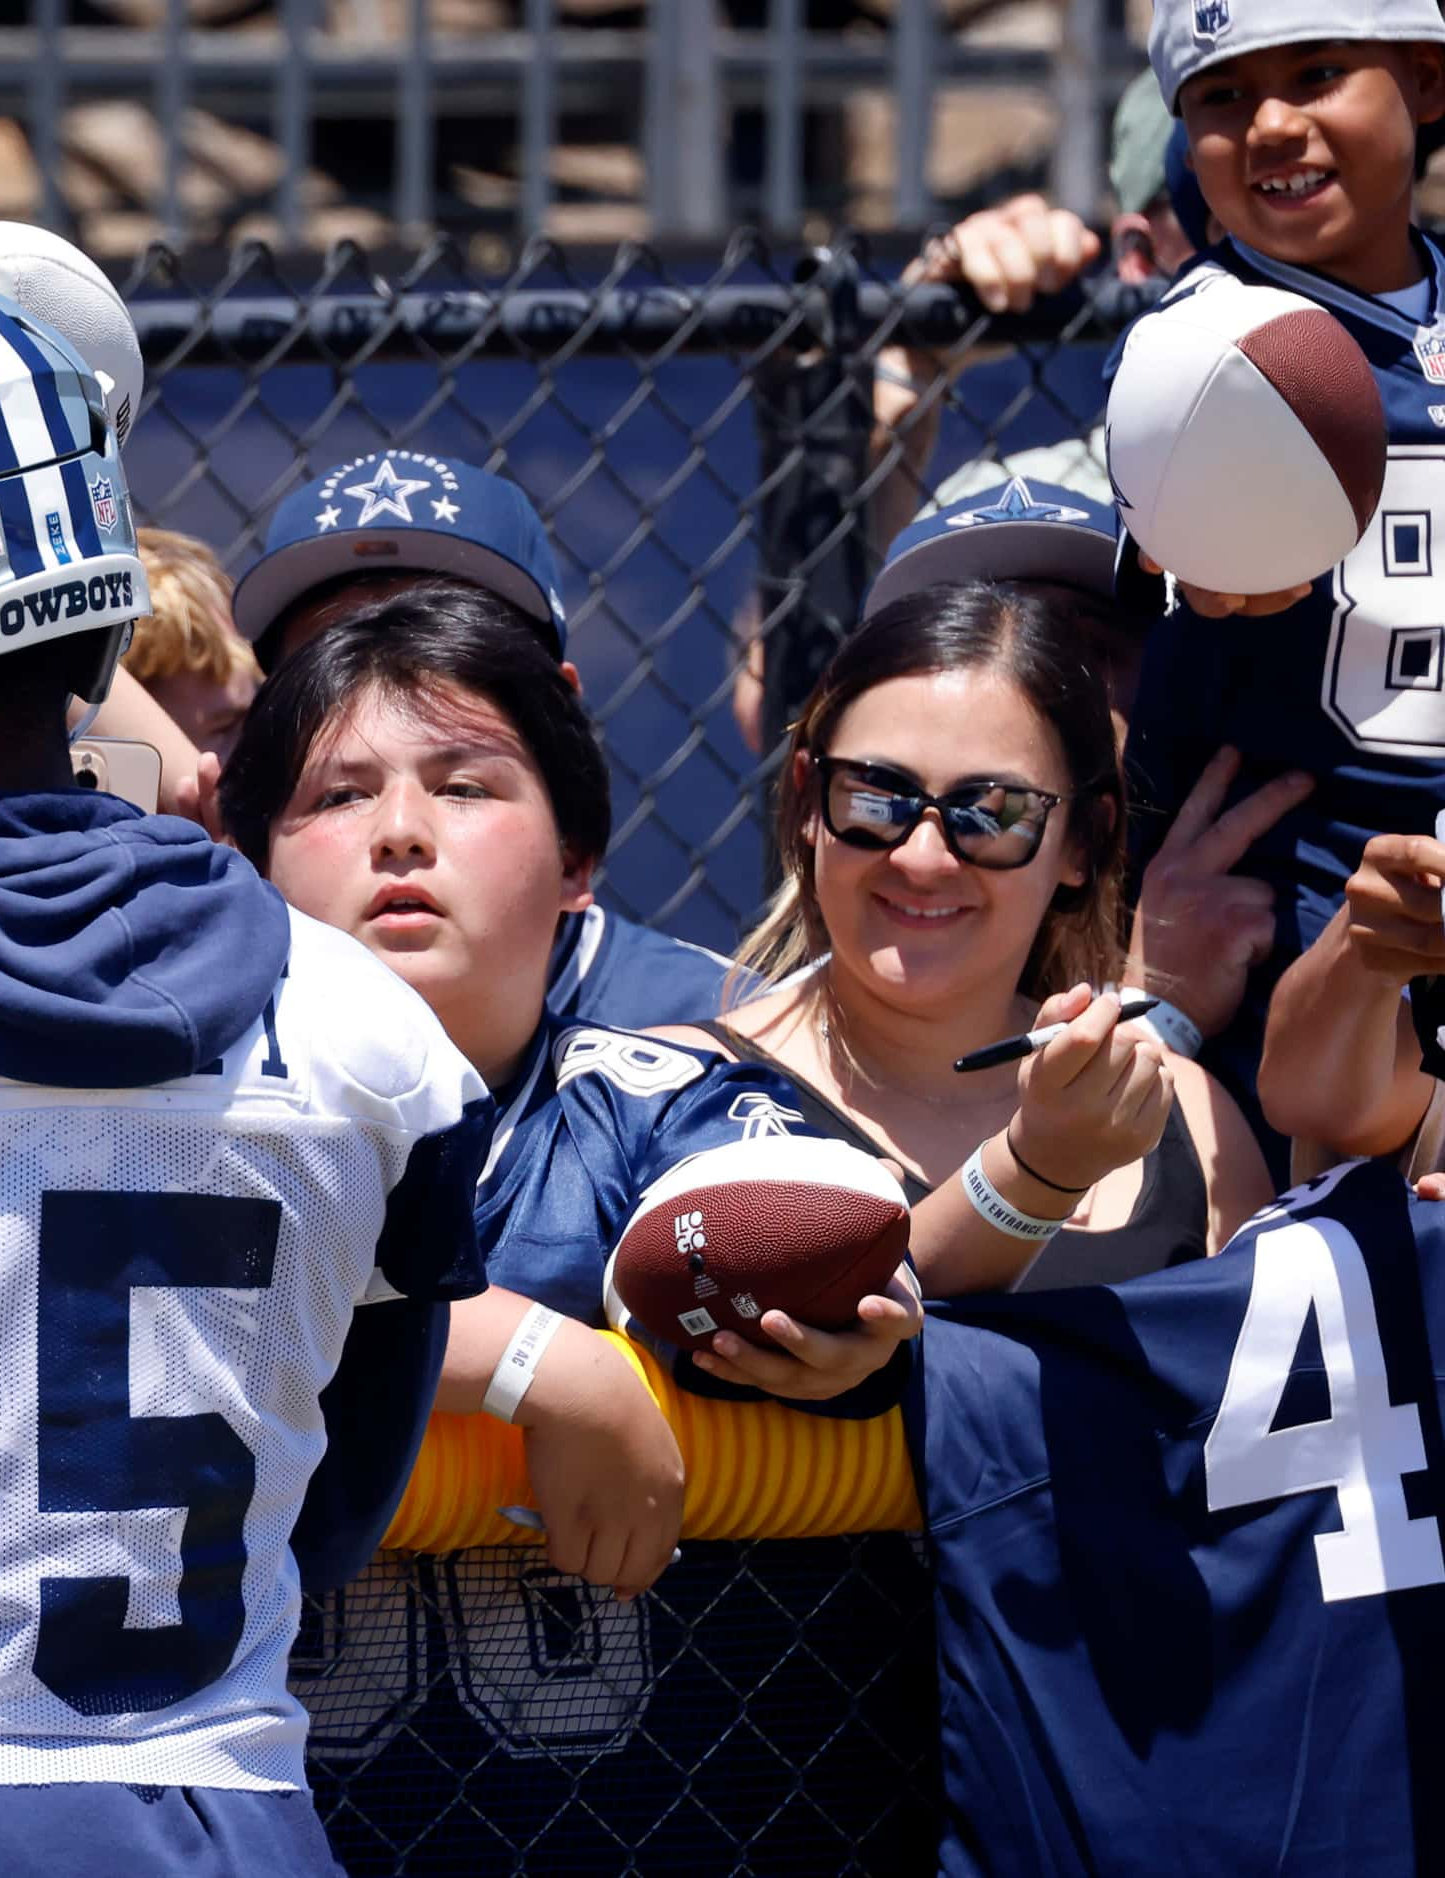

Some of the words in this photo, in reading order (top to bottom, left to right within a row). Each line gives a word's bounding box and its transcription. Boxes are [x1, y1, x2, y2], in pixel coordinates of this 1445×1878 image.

[49, 514, 68, 559] ZEKE
[97, 500, 117, 528] NFL
[967, 1169, 991, 1204] EARLY
[988, 1202, 1043, 1235] ENTRANCE
[1204, 1216, 1445, 1603] 4
